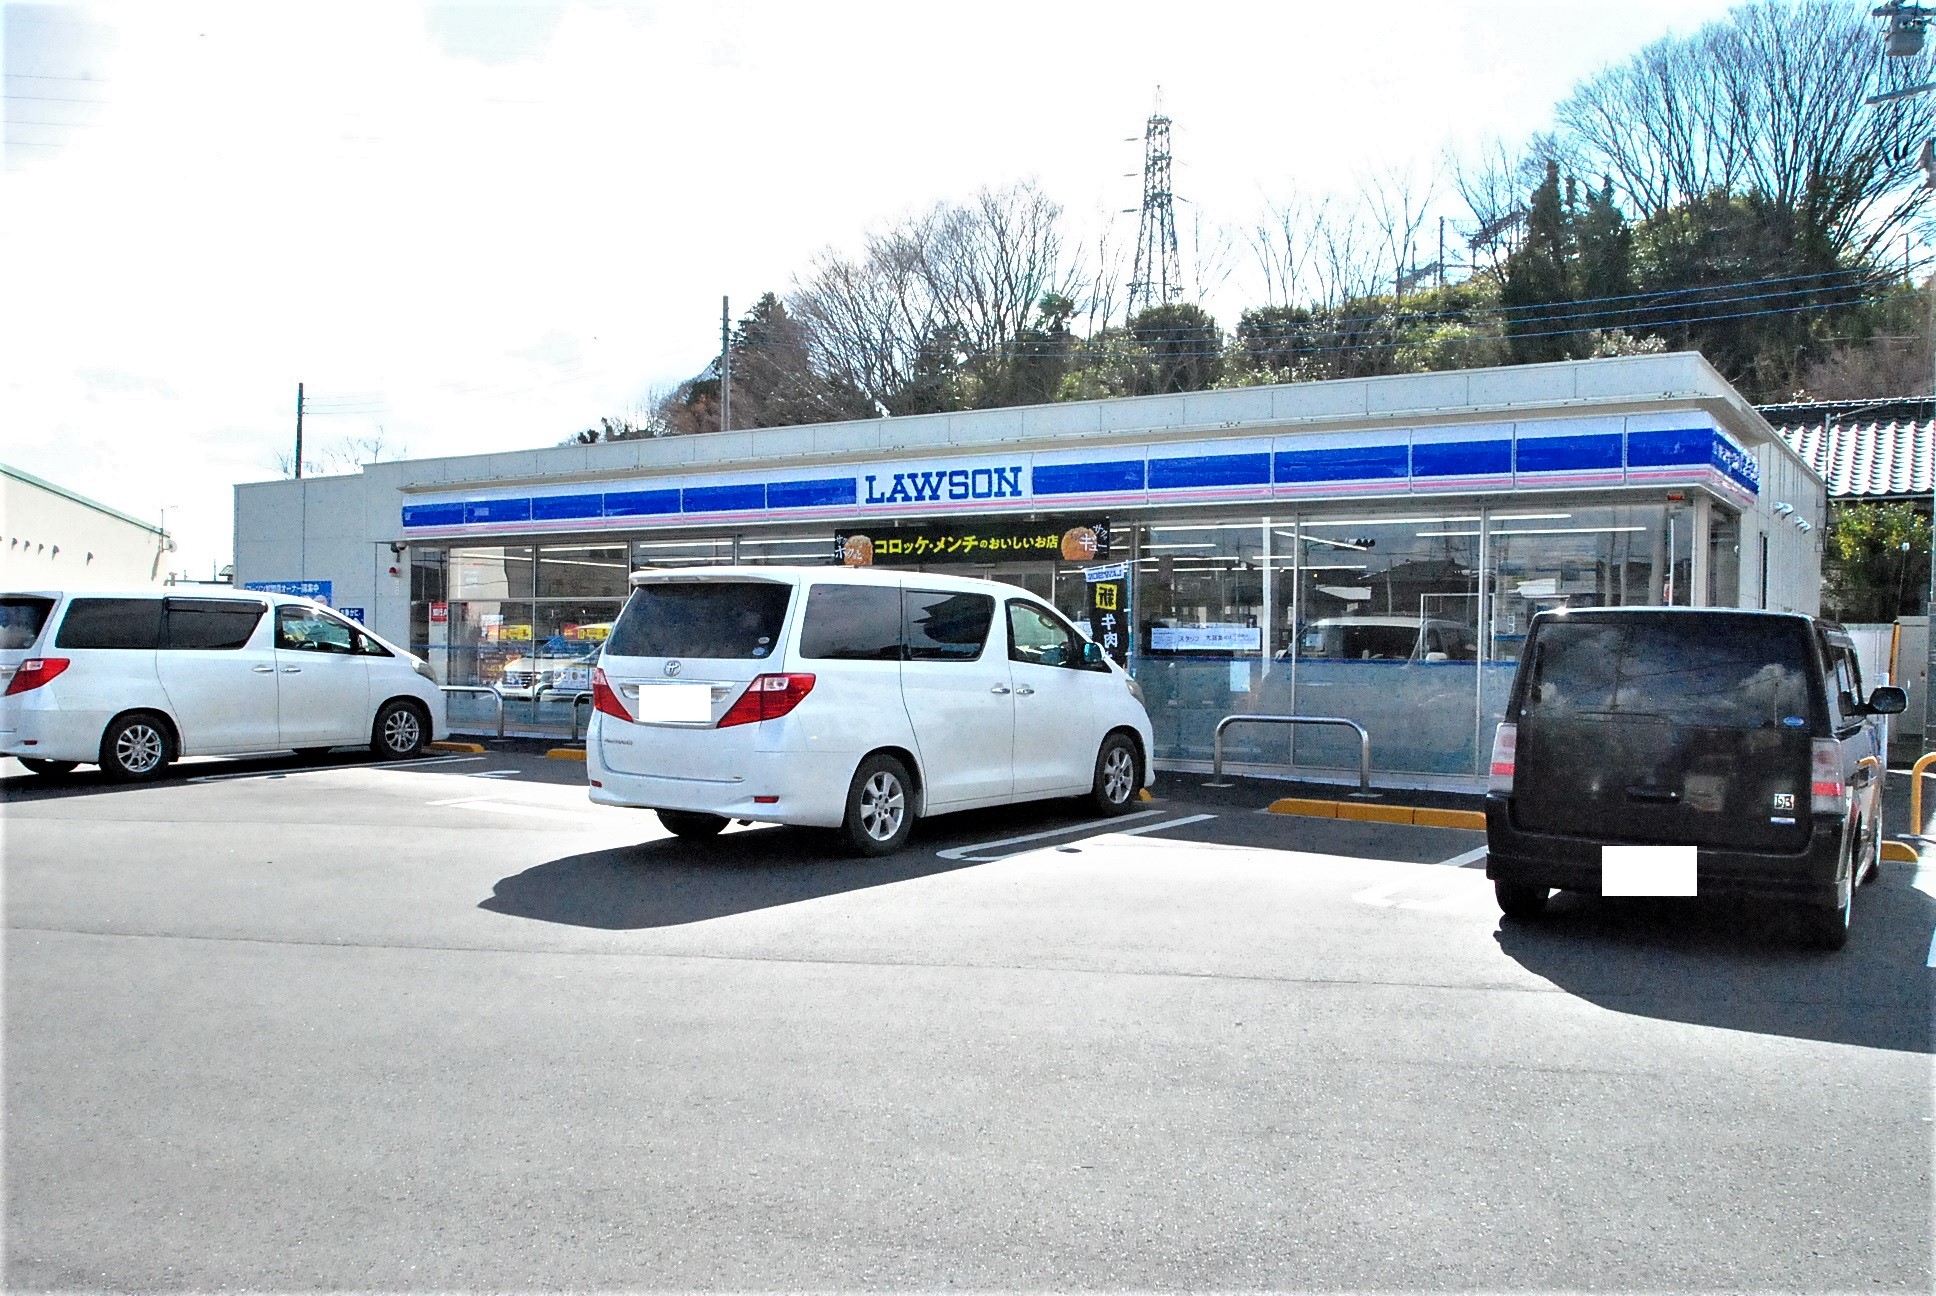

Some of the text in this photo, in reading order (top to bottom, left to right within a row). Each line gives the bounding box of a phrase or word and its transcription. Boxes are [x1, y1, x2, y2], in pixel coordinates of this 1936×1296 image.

[865, 466, 1022, 504] LAWSON
[874, 534, 1058, 555] コロッケ・メンチのおいしいお店
